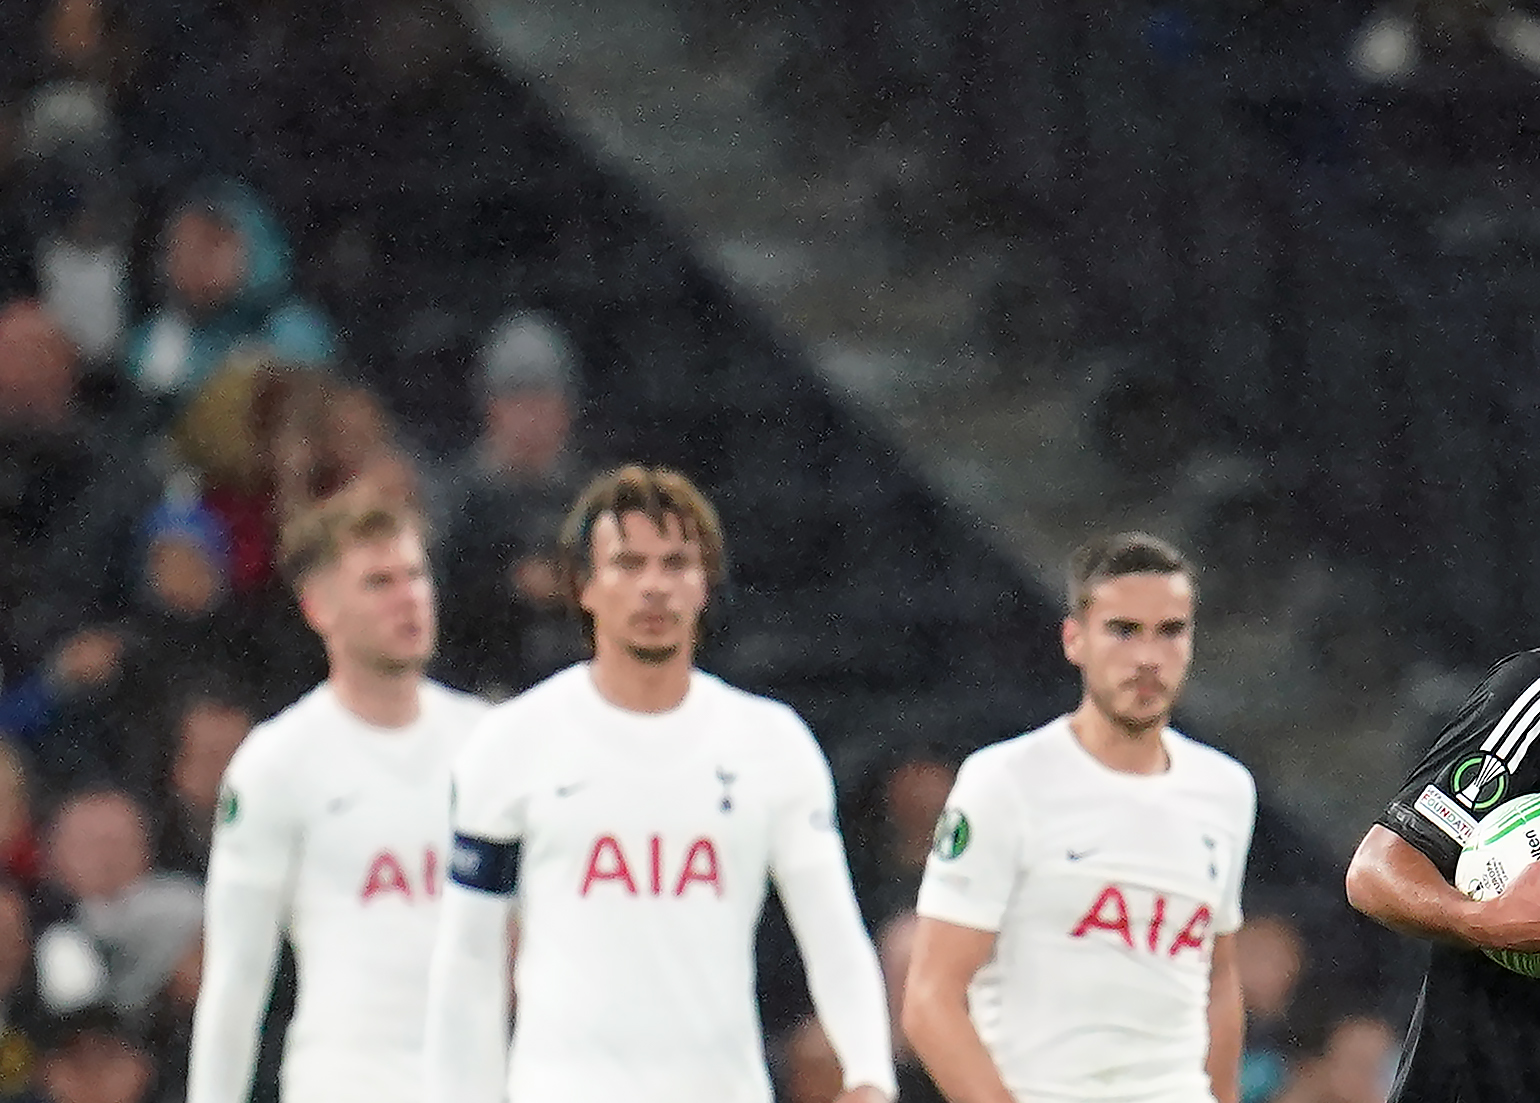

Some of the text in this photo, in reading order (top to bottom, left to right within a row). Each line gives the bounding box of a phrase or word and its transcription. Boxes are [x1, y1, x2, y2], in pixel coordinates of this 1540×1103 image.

[1421, 793, 1473, 839] FOUNDATI
[359, 847, 441, 904] AI
[578, 835, 724, 899] AIA
[1068, 884, 1213, 958] AIA
